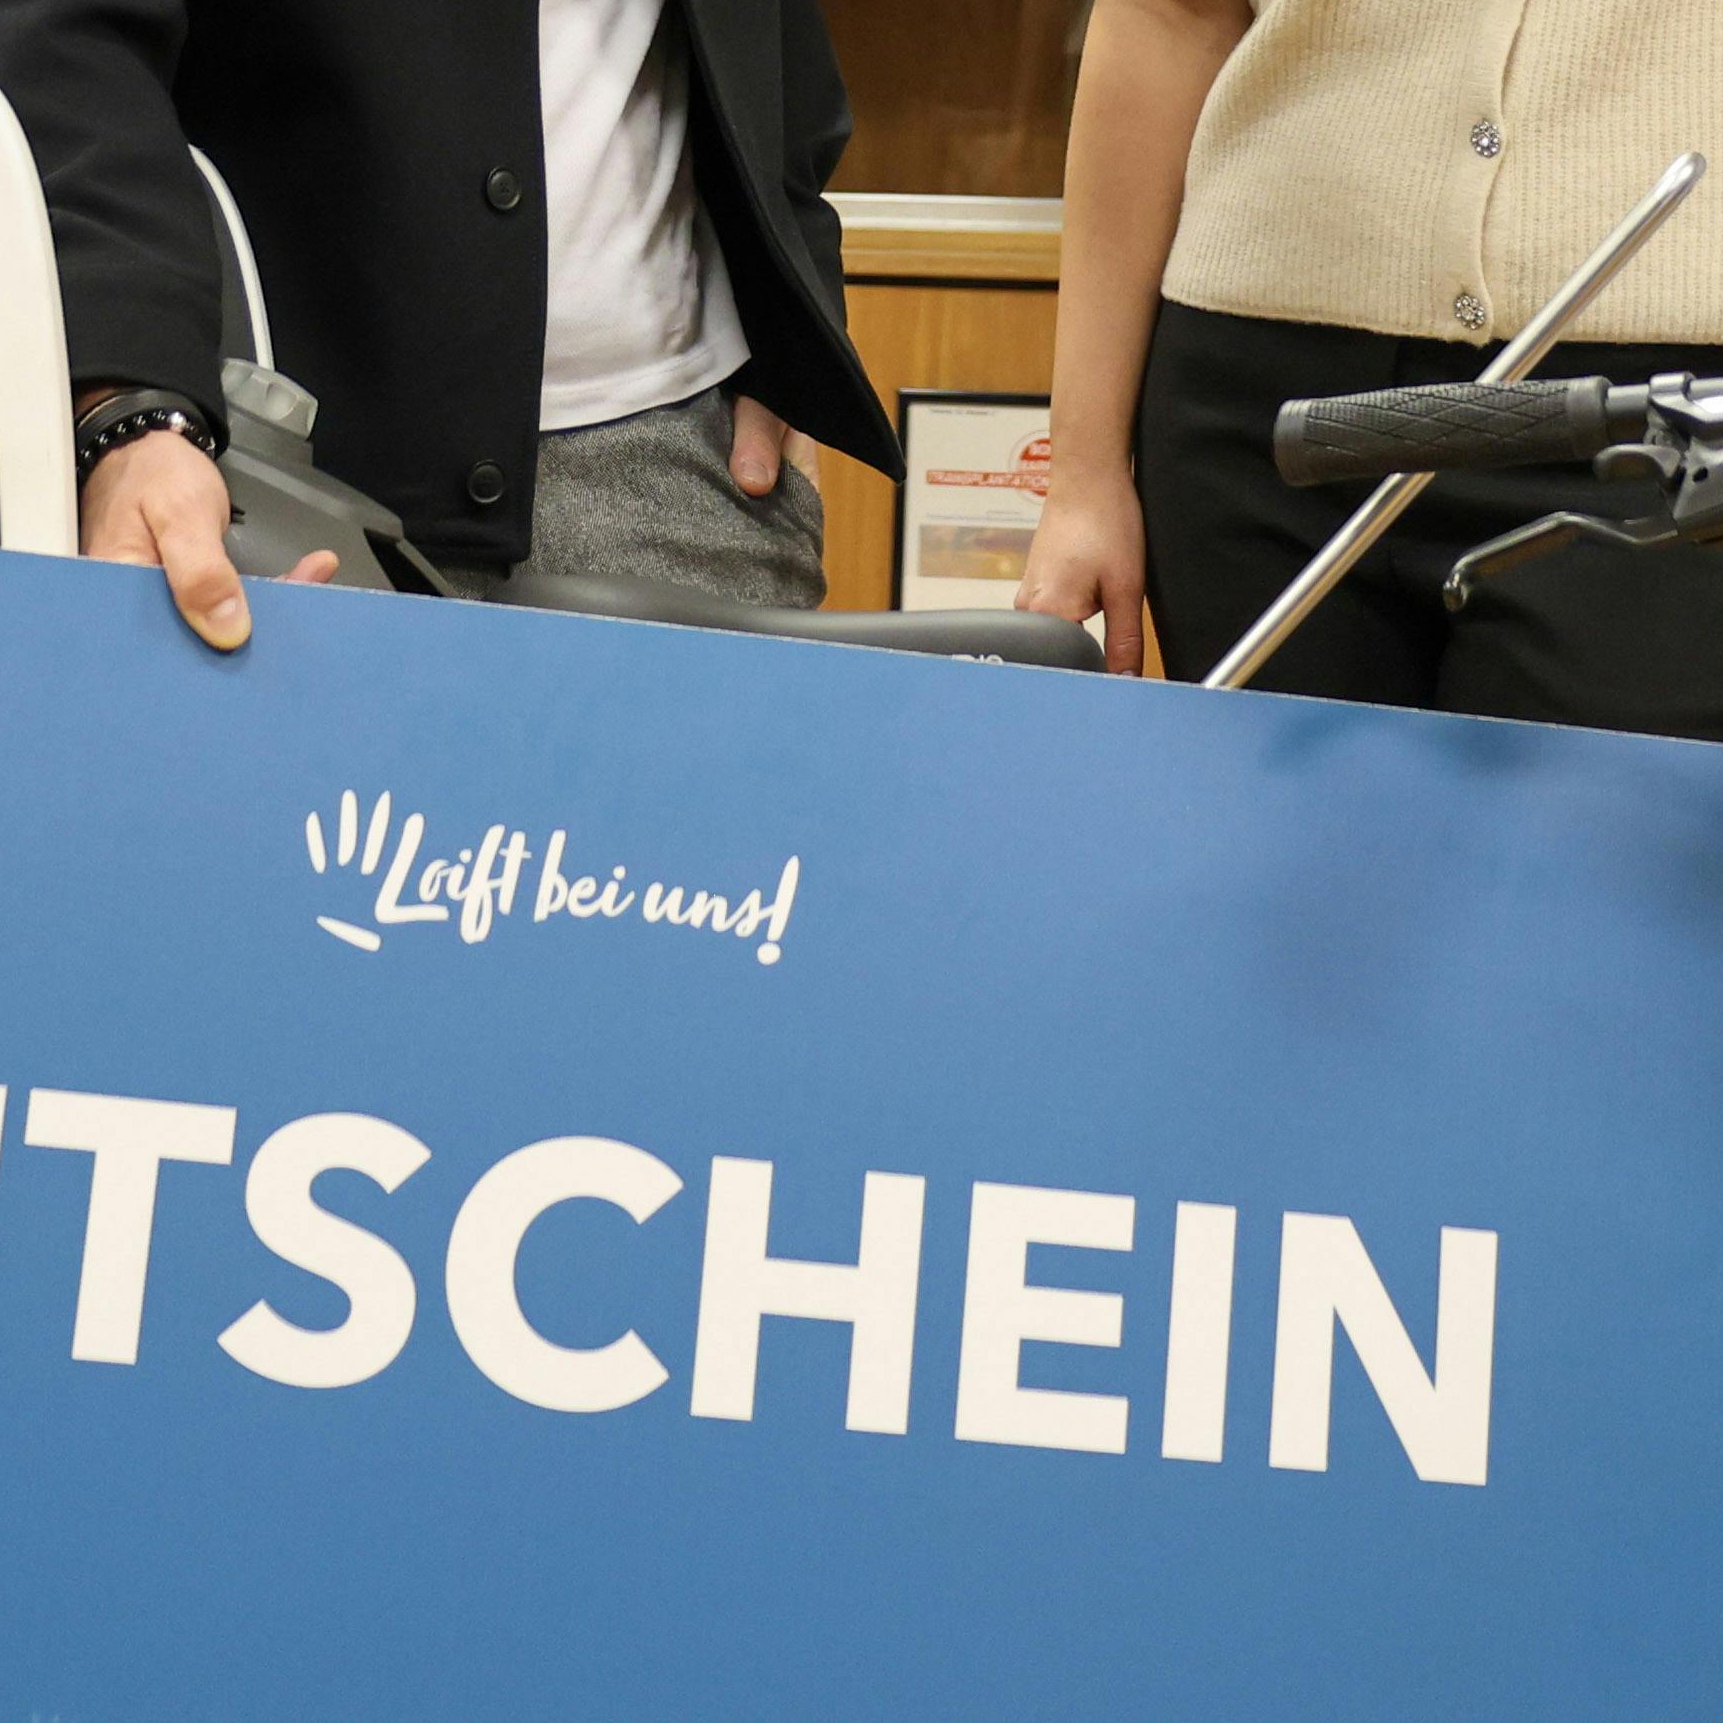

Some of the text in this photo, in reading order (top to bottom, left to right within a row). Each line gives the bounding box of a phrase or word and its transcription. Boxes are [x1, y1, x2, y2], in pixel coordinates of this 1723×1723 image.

[375, 813, 801, 966] Loift bei uns!
